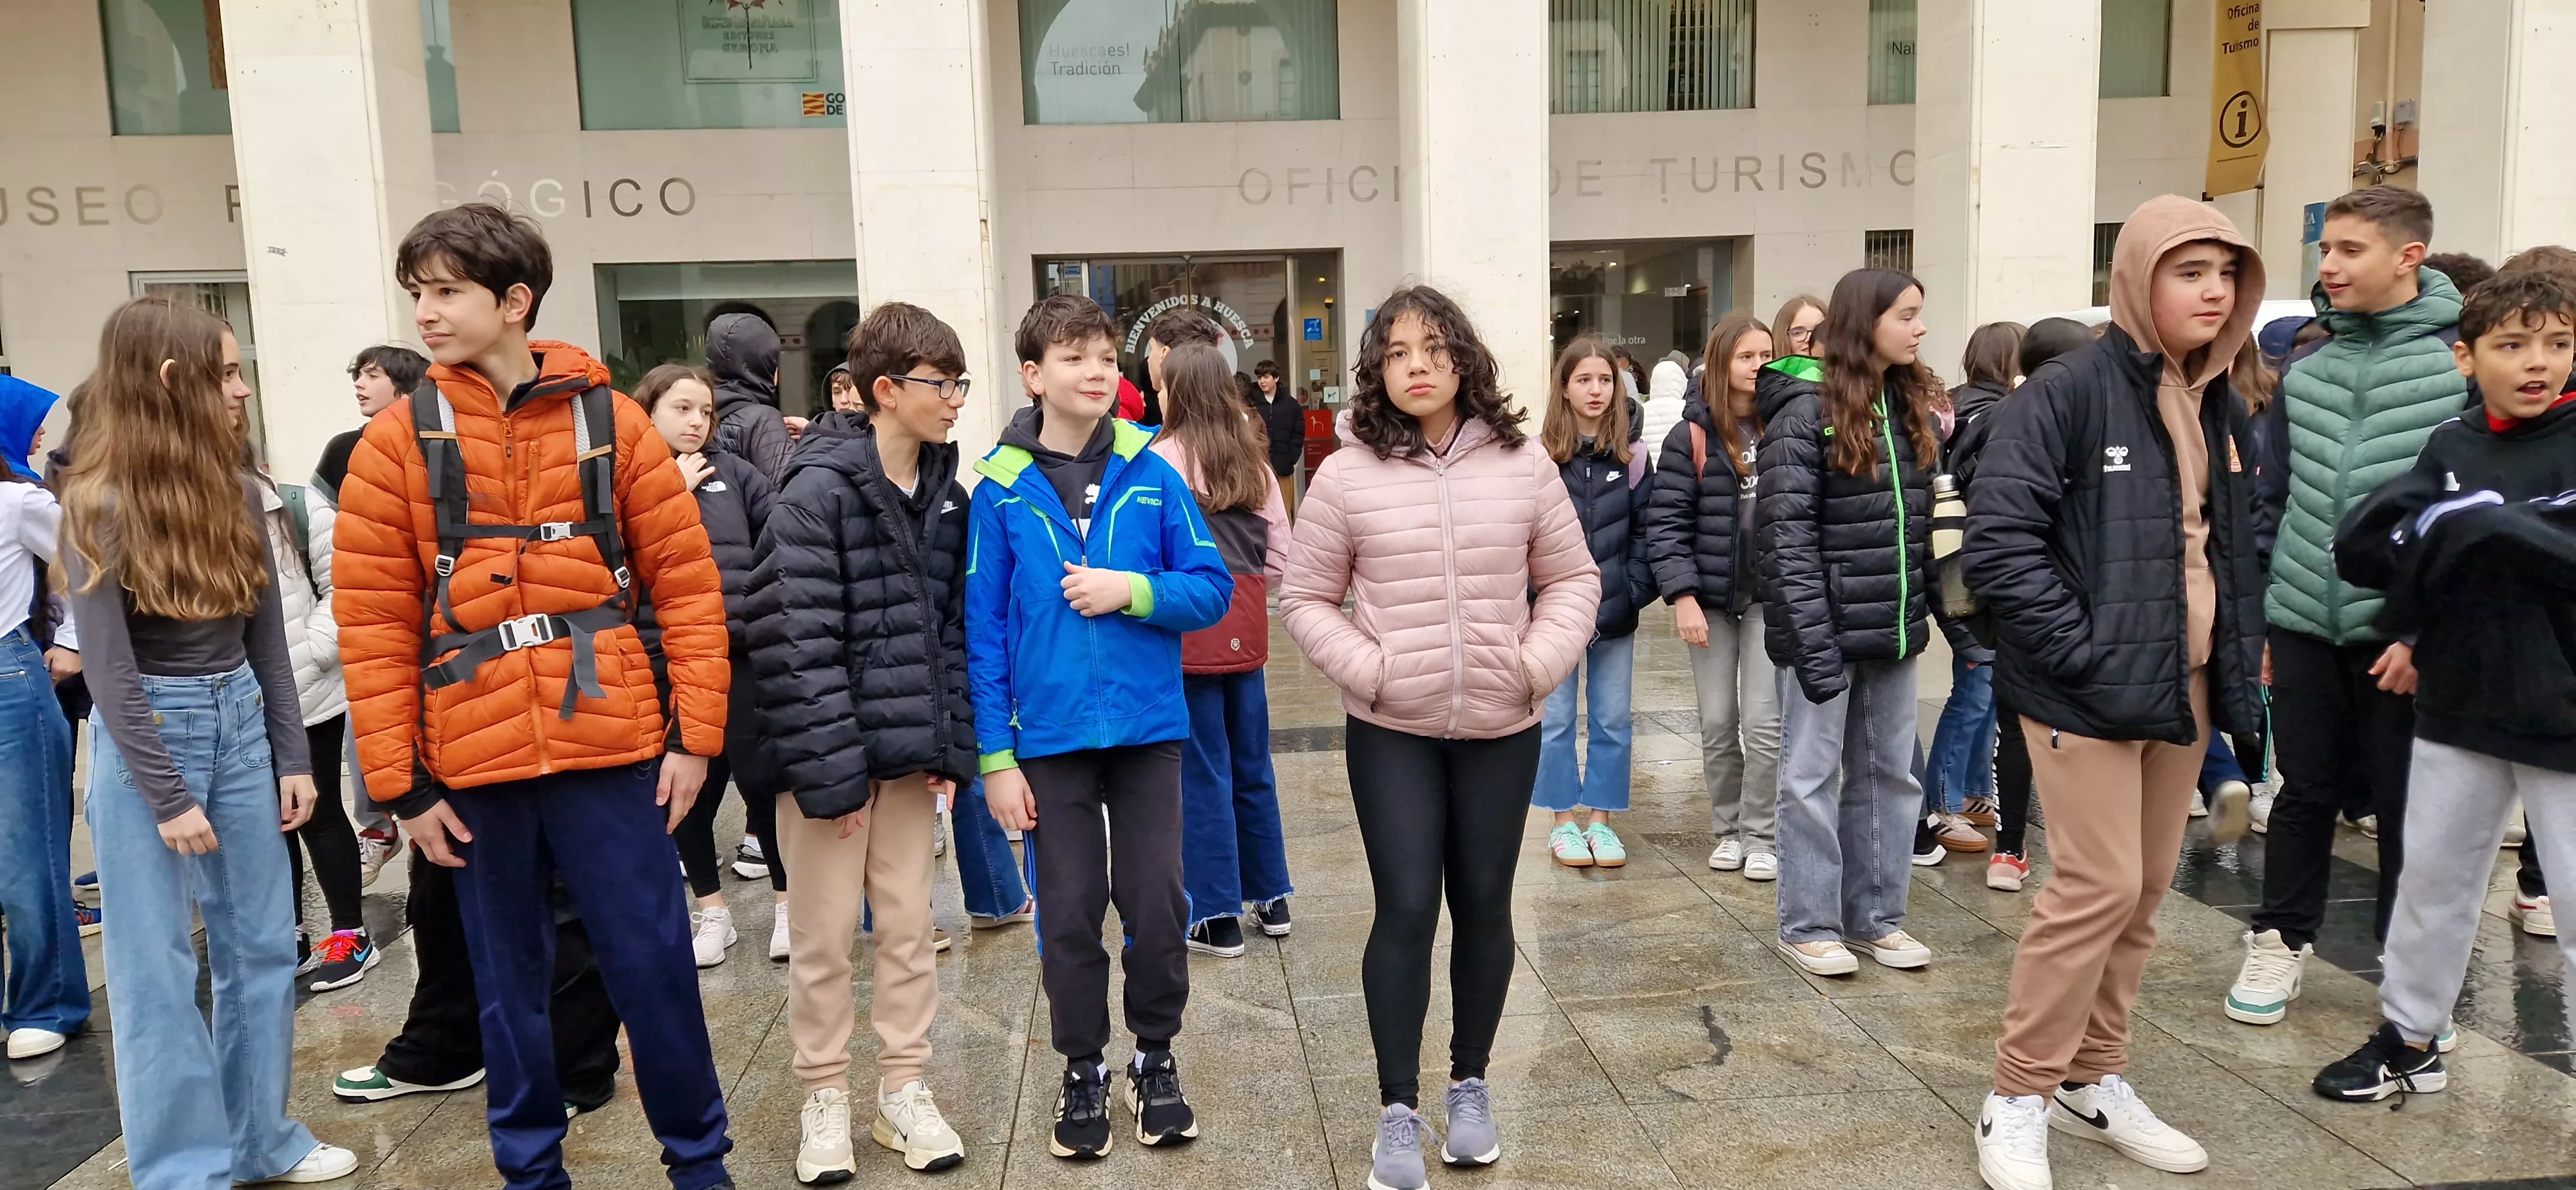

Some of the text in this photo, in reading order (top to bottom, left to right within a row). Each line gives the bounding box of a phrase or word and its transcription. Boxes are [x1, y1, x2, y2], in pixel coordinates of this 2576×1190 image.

[2228, 3, 2259, 19] Oficina
[2248, 18, 2259, 31] de
[1050, 61, 1121, 75] Tradición
[826, 92, 845, 104] GO
[826, 105, 843, 115] DE
[1125, 294, 1255, 354] BIENVENIDOS A HUESCA
[1618, 335, 1626, 345] la
[1628, 335, 1646, 345] otra
